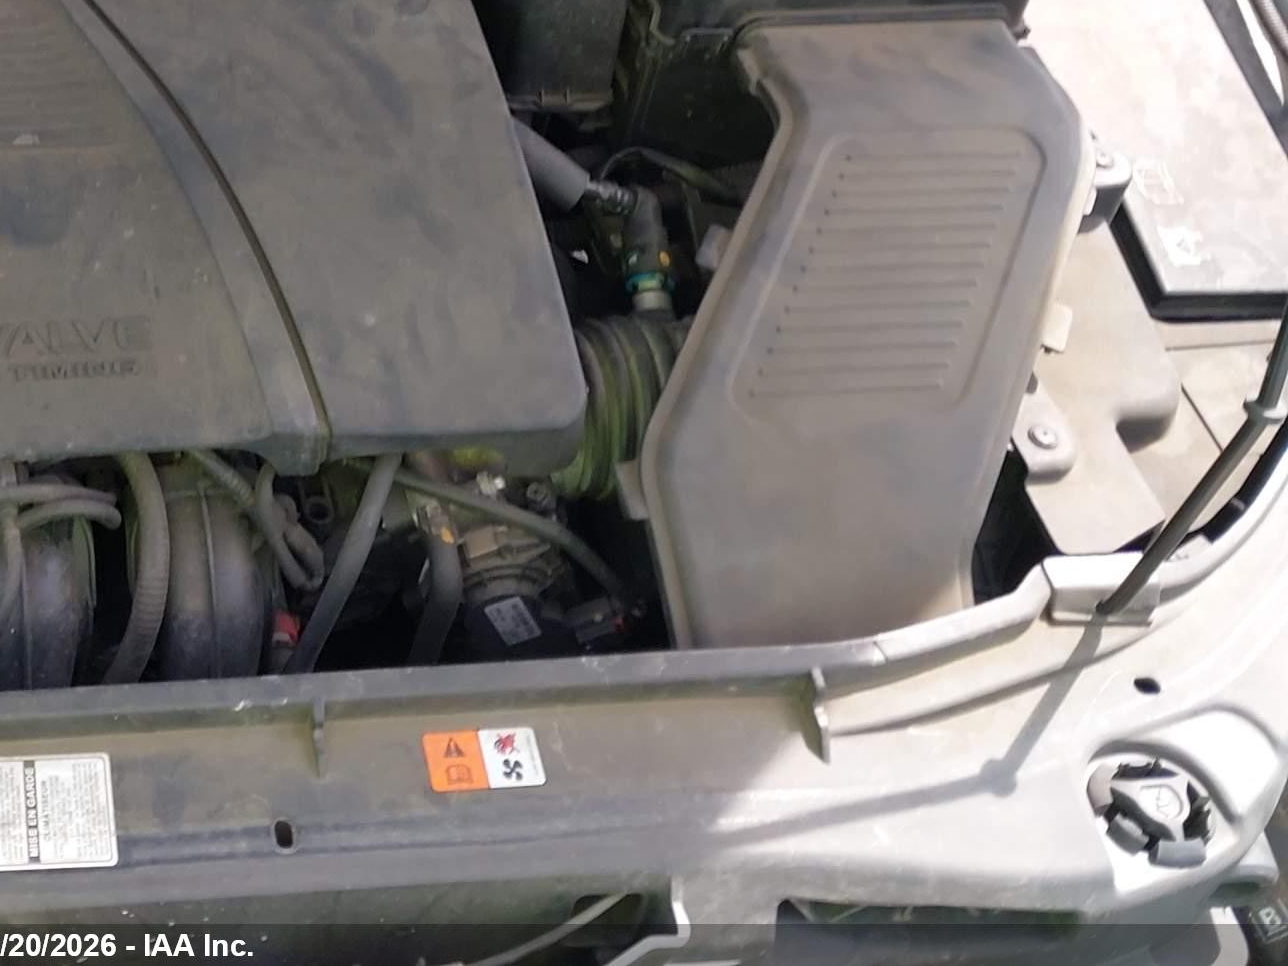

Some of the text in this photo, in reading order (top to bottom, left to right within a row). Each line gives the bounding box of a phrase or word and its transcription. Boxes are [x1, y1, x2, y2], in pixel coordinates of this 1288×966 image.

[11, 358, 140, 382] TIMING
[25, 766, 39, 858] MISE EN GARDE
